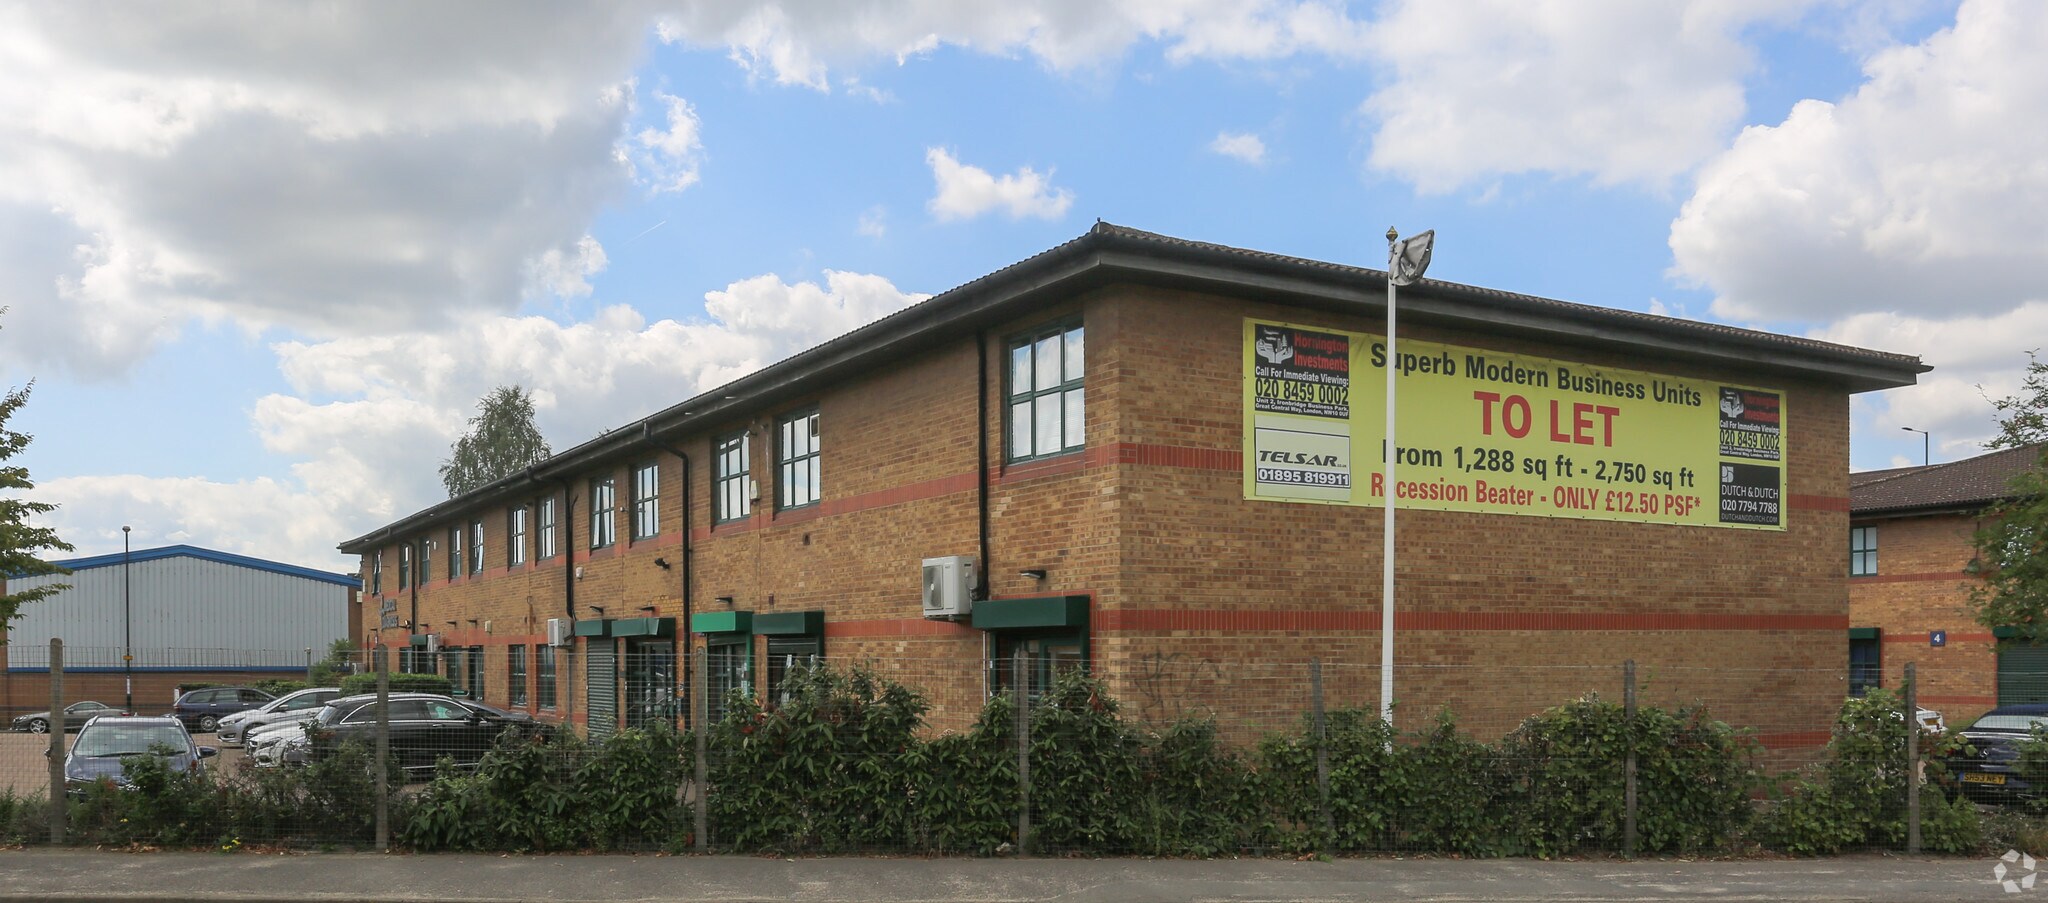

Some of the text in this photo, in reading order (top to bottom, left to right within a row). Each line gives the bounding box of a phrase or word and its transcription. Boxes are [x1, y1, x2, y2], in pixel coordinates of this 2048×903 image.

[1294, 333, 1348, 355] Hornington
[1294, 350, 1348, 372] Investments
[1255, 366, 1349, 387] Call For Immediate Viewing:
[1465, 355, 1548, 388] Modern
[1557, 367, 1645, 400] Business
[1653, 380, 1701, 407] Units
[1255, 378, 1349, 406] 020 8459 0002
[1307, 402, 1333, 410] Business
[1473, 390, 1620, 448] TO LET
[1720, 420, 1728, 428] Call
[1720, 429, 1735, 445] 020
[1738, 431, 1757, 448] 8459
[1760, 434, 1780, 450] 0002
[1259, 450, 1338, 467] TELSAR
[1382, 439, 1442, 467] rom
[1454, 446, 1515, 473] 1,288
[1523, 457, 1547, 481] sq
[1555, 454, 1573, 478] ft
[1595, 460, 1646, 484] 2,750
[1652, 469, 1673, 491] sq
[1679, 467, 1694, 488] ft
[1259, 469, 1349, 485] 01895 819911
[1371, 472, 1468, 502] Rcession
[1475, 479, 1534, 506] Beater
[1553, 485, 1600, 510] ONLY
[1605, 490, 1659, 515] £12.50
[1721, 484, 1779, 499] DUTCH & DUTCH
[1721, 499, 1778, 514] 020 7794 7788
[1933, 633, 1941, 643] 4
